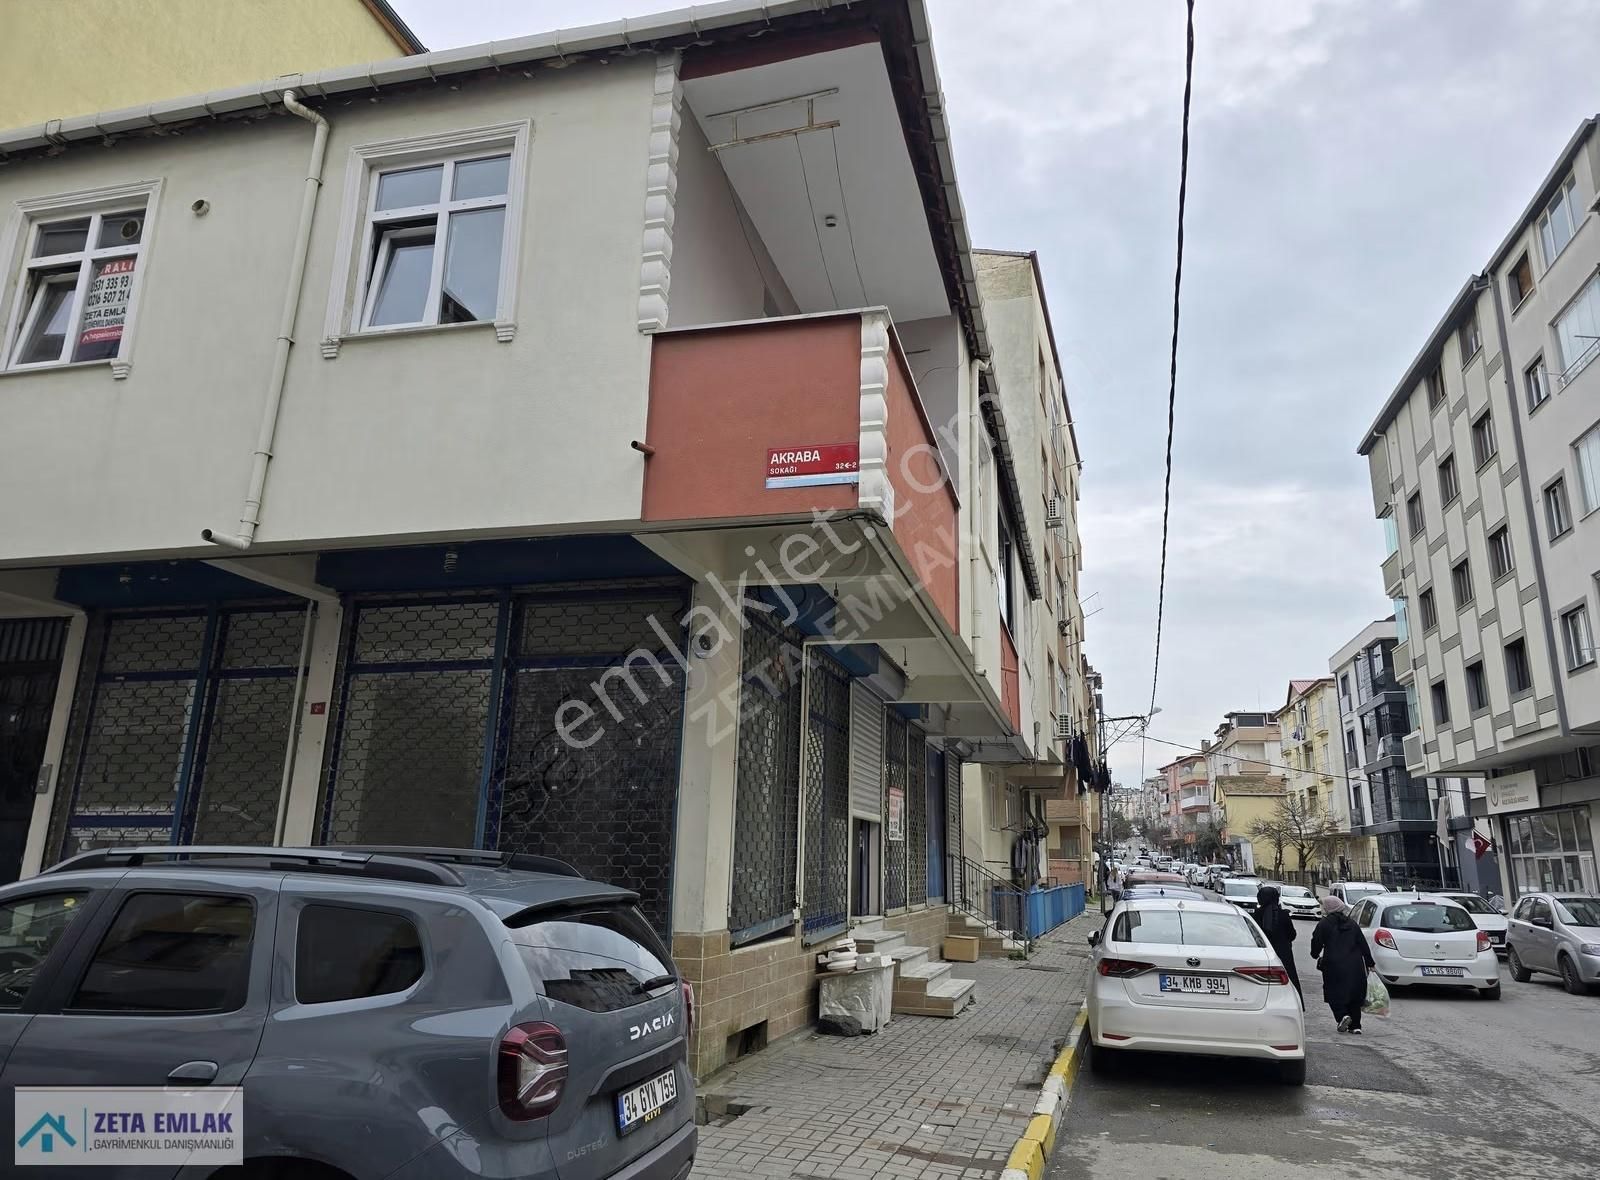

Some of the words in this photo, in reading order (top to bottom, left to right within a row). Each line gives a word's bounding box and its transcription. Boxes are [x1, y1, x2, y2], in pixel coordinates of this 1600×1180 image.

[101, 261, 133, 274] RALI
[106, 277, 118, 290] 335
[120, 275, 129, 288] 93
[88, 293, 101, 306] 0216
[103, 290, 116, 303] 507
[118, 290, 125, 302] 21
[84, 309, 102, 320] ZETA
[104, 306, 126, 317] EMLA
[770, 450, 820, 465] AKRABA
[770, 466, 797, 475] SOKAĞI
[1166, 976, 1178, 987] 34
[1183, 977, 1202, 989] KMB
[1206, 979, 1225, 990] 994
[629, 1013, 674, 1041] DACIA
[624, 1093, 638, 1122] 34
[639, 1085, 658, 1112] GYN
[658, 1072, 675, 1103] 759
[644, 1107, 661, 1123] KIYI
